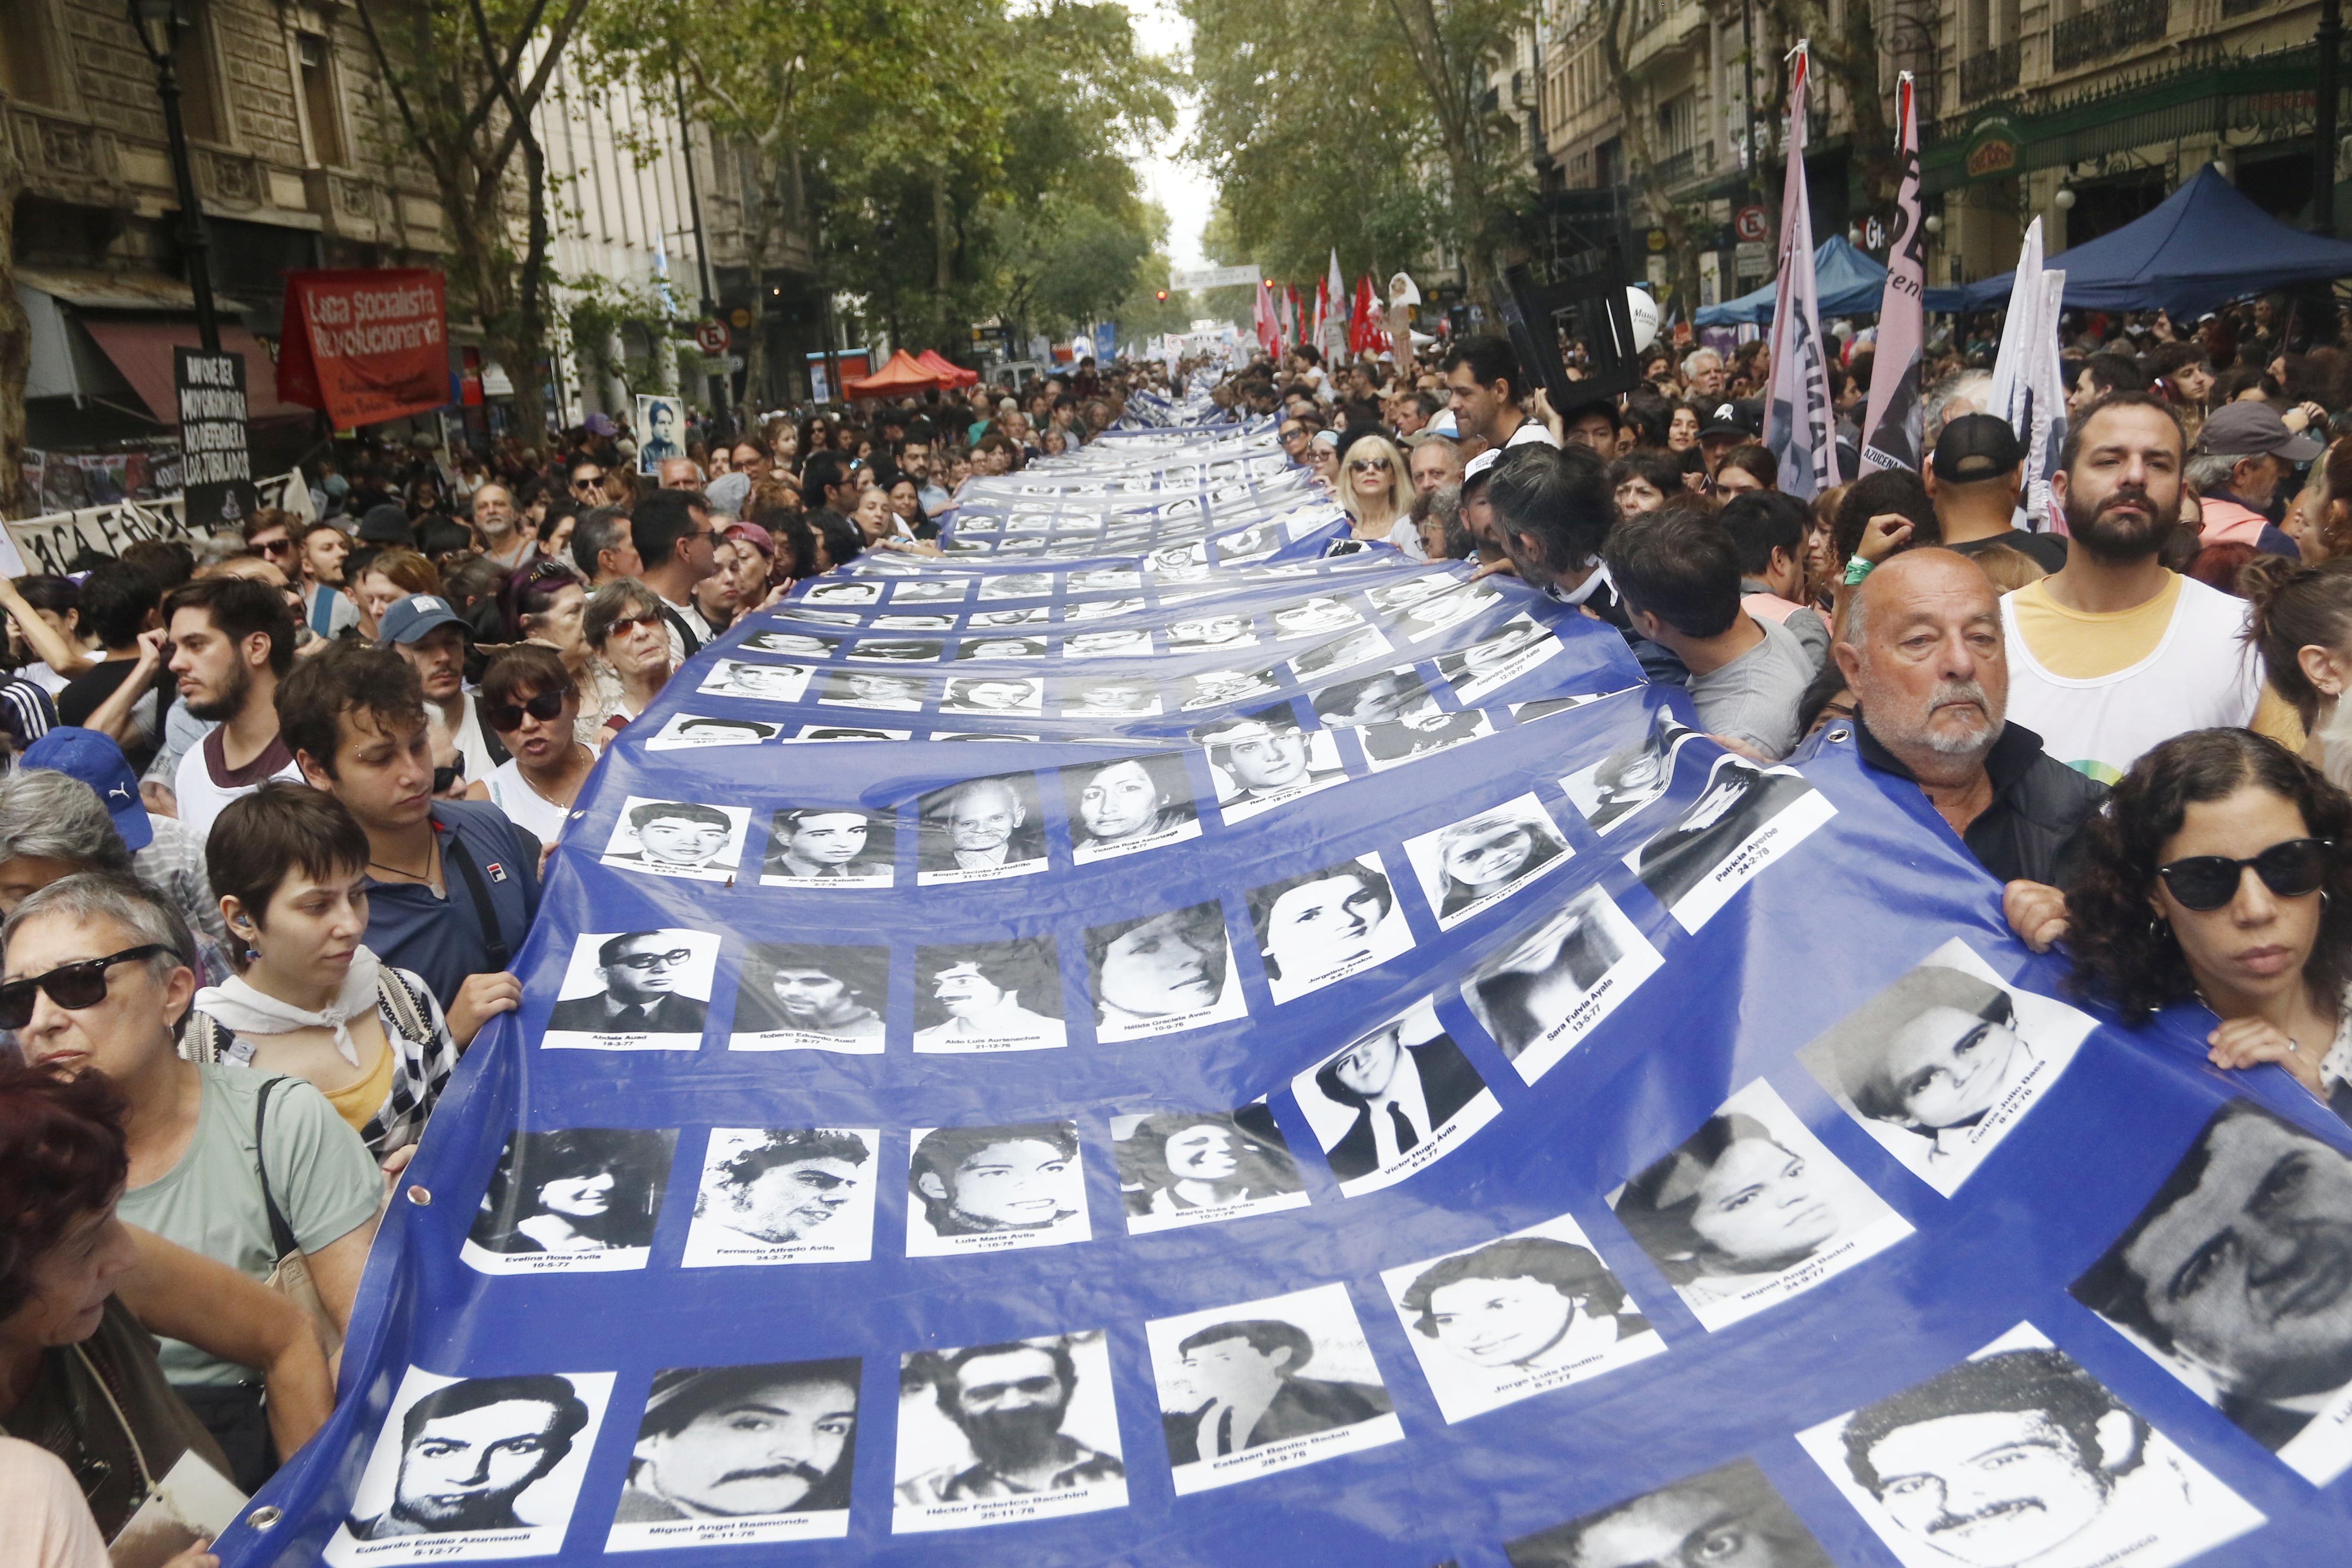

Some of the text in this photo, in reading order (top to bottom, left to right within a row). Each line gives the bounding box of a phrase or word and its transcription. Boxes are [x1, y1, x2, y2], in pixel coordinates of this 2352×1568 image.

[353, 284, 438, 322] Socialista
[312, 318, 441, 358] Revolucionaria
[1477, 648, 1541, 687] Alejandro Marcos Astiz
[1499, 665, 1524, 680] 12-10-77
[1093, 843, 1120, 853] Victoria
[1142, 830, 1178, 843] Asturizaga
[1715, 827, 1778, 883] Patricia Ayerbe
[993, 862, 1031, 871] Astudillo
[1451, 854, 1564, 919] Lucrecia Mercedes Avellaneda
[1308, 955, 1373, 984] Jorgelina Avalos
[1152, 1016, 1187, 1026] Graciela
[1188, 1010, 1211, 1019] Avalo
[1547, 979, 1613, 1041] Sara Fulvia Ayala
[1573, 1003, 1600, 1032] 13-5-77
[796, 1032, 832, 1042] Eduardo
[1971, 1112, 1999, 1144] Carlos
[2001, 1086, 2022, 1110] Julio
[1411, 1141, 1435, 1159] Hugo
[1437, 1124, 1457, 1142] Ávila
[1412, 1148, 1438, 1168] 6-4-77
[1741, 1280, 1780, 1300] Miguel
[1783, 1262, 1816, 1282] Angel
[1494, 1354, 1604, 1393] Jorge Luis Badillo
[1213, 1451, 1264, 1469] Esteban
[1266, 1441, 1307, 1455] Benito
[926, 1490, 1089, 1516] Héctor Federico Bacchini
[649, 1518, 810, 1535] Miguel Angel Baamonde
[355, 1533, 532, 1554] Eduardo Emilio Azurmendi
